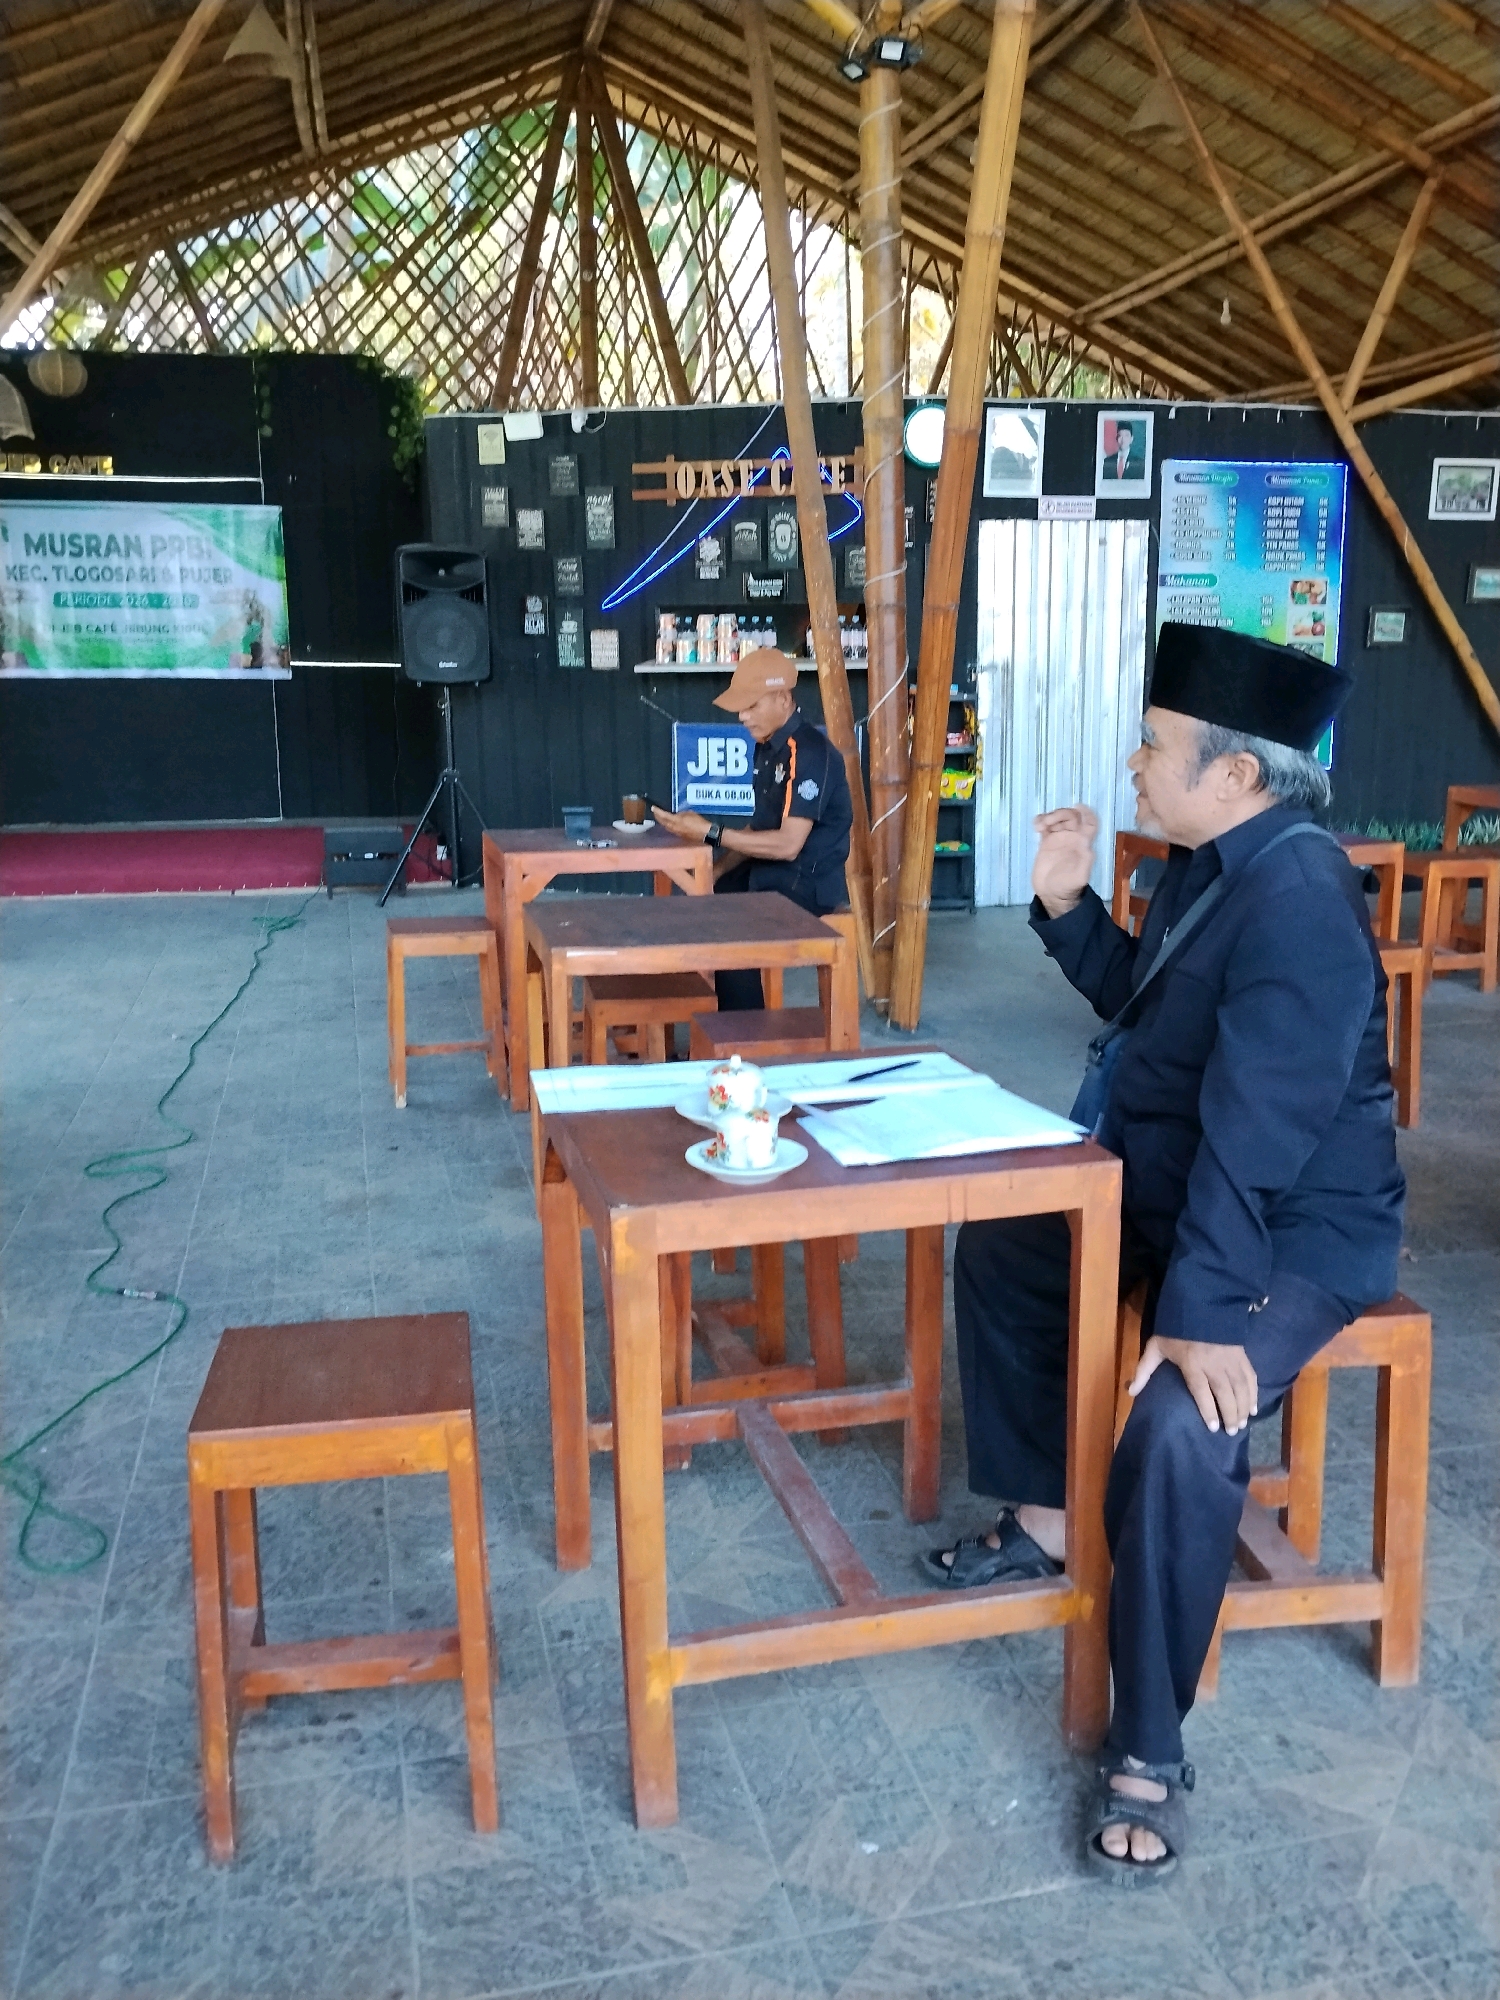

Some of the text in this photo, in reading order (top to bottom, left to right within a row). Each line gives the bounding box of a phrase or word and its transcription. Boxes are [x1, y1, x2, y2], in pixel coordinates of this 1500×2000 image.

[676, 456, 846, 499] OASE CE
[23, 533, 143, 558] MUSRAN
[6, 565, 48, 583] KEC.
[52, 565, 156, 583] TLOGOSARI
[1164, 574, 1210, 587] Makanan
[687, 737, 749, 777] JEB
[695, 789, 721, 800] BUKA
